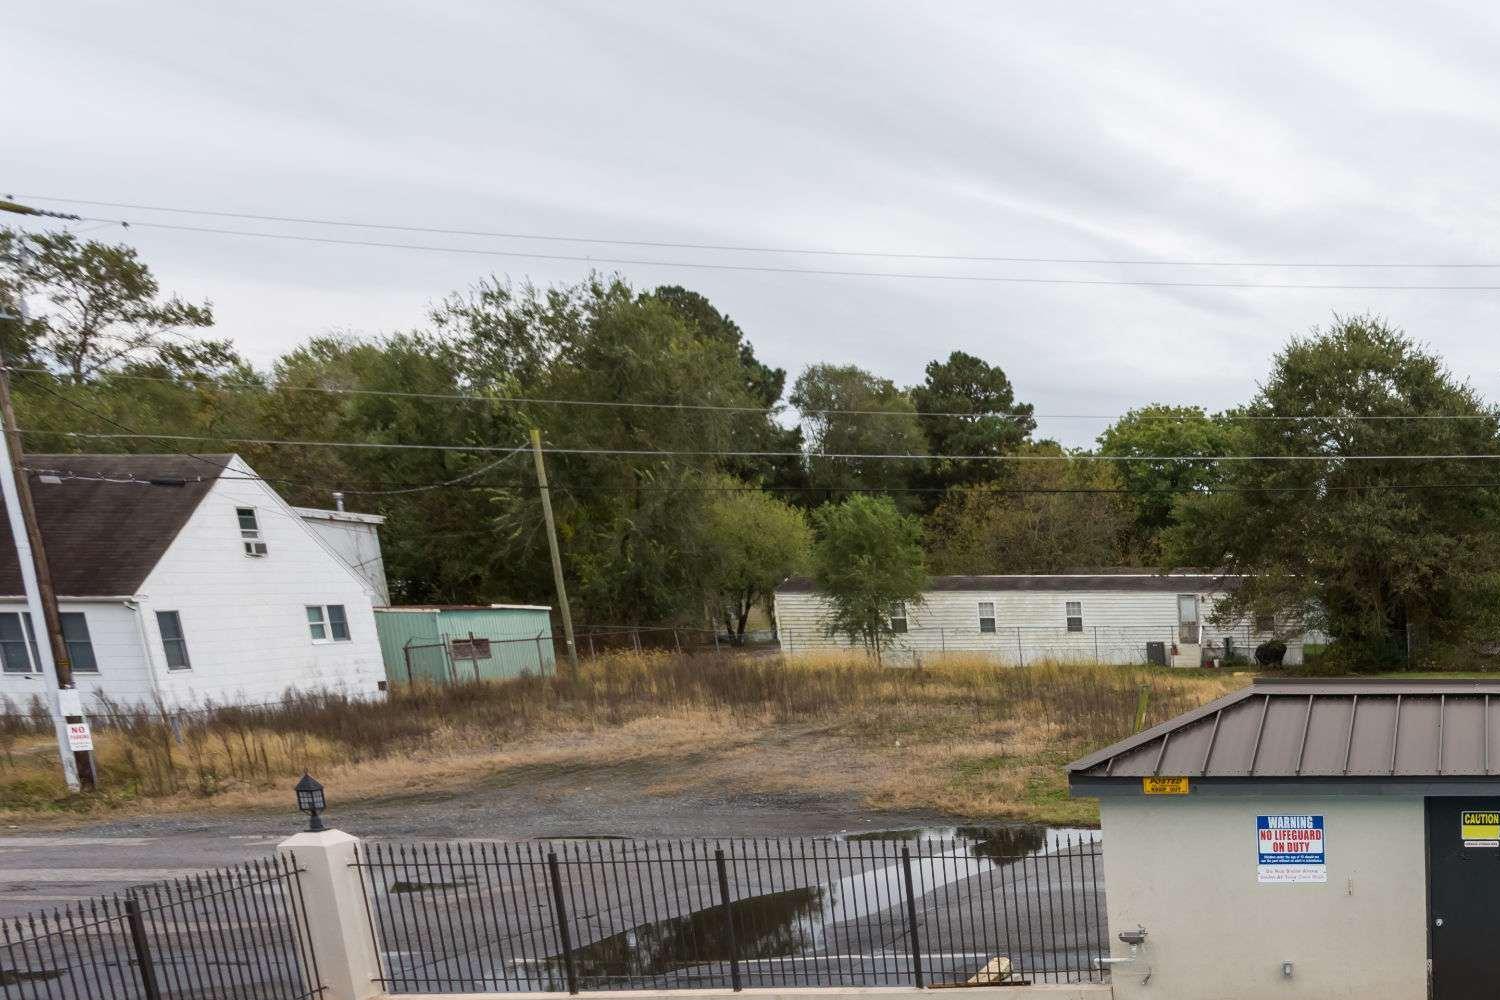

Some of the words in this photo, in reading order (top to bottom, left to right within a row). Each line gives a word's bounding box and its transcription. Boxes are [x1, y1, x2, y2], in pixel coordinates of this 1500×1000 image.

[71, 726, 85, 734] NO
[1267, 816, 1314, 829] WARNING
[1464, 813, 1500, 824] CAUTION
[1260, 829, 1272, 841] NO
[1275, 829, 1322, 841] LIFEGUARD
[1272, 842, 1285, 852] ON
[1287, 842, 1310, 852] DUTY
